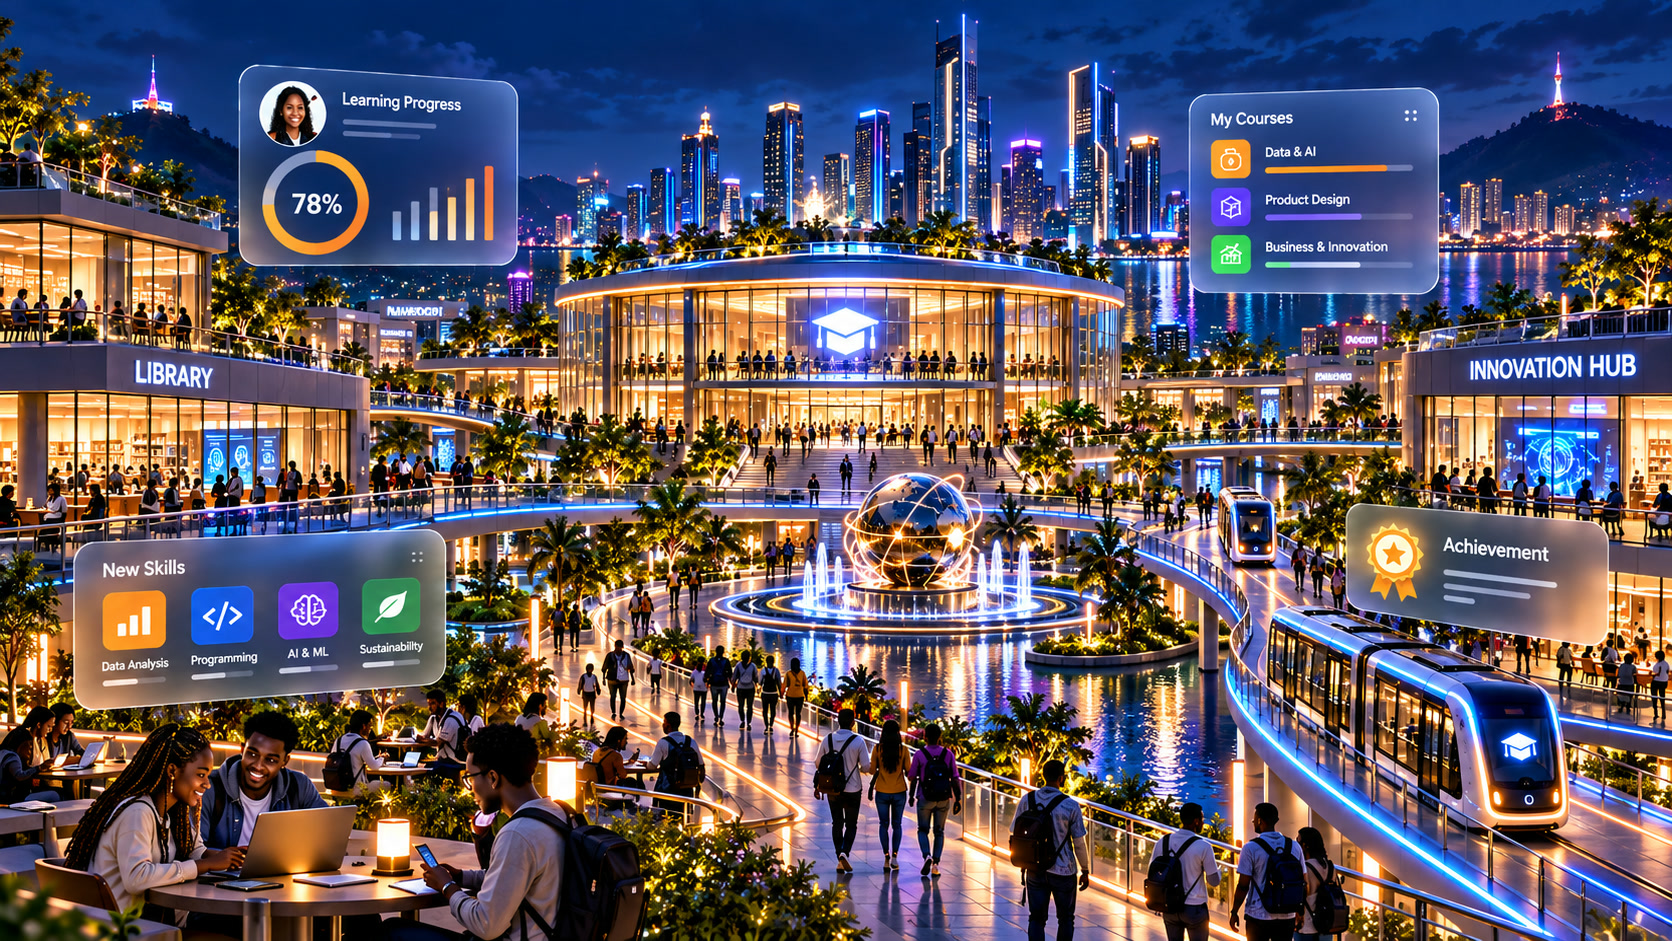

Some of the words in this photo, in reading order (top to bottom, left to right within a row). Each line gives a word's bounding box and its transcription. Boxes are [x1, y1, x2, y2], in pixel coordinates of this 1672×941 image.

[343, 92, 400, 111] Learning
[404, 96, 461, 113] Progress
[1211, 113, 1232, 128] My
[1236, 112, 1293, 125] Courses
[1266, 147, 1290, 157] Data
[1294, 146, 1302, 157] &
[1305, 146, 1316, 156] AI
[292, 193, 342, 214] 78%
[1266, 194, 1309, 205] Product
[1312, 194, 1350, 207] Design
[1266, 241, 1314, 252] Business
[1317, 241, 1325, 252] &
[1329, 241, 1388, 252] Innovation
[136, 360, 213, 388] LIBRARY
[1470, 356, 1581, 380] INNOVATION
[1590, 354, 1636, 376] HUB
[1443, 537, 1549, 562] Achievement
[103, 563, 140, 578] New
[144, 559, 185, 576] Skills
[191, 652, 257, 666] Programming
[288, 649, 298, 658] AI
[302, 648, 309, 657] &
[313, 647, 328, 656] ML
[102, 662, 125, 671] Data
[128, 658, 169, 670] Analysis
